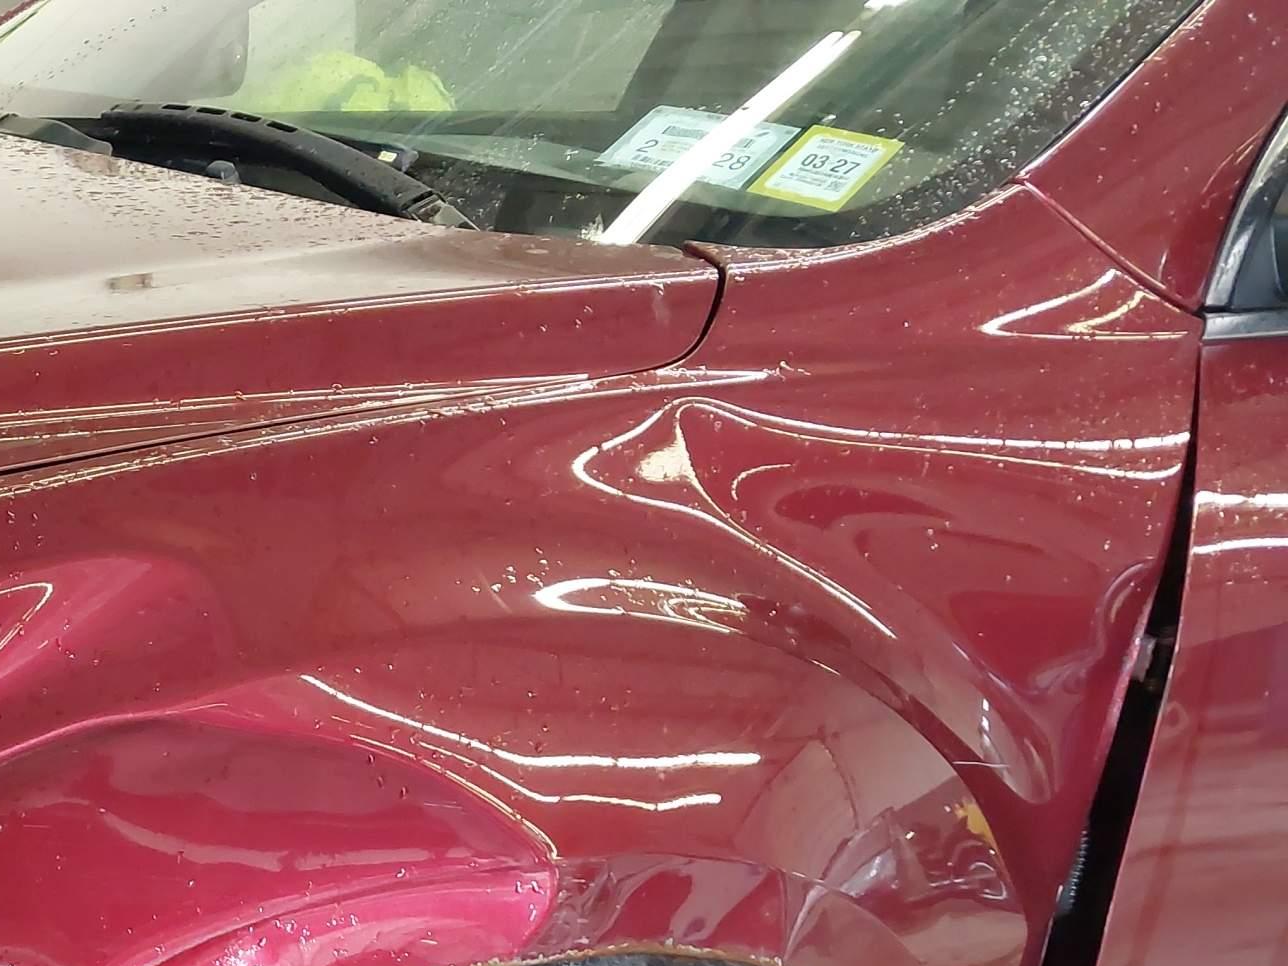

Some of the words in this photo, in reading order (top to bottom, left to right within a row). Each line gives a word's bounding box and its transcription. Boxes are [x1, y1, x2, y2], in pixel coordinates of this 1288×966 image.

[711, 152, 752, 171] 28
[800, 153, 830, 169] 03
[829, 158, 862, 175] 27
